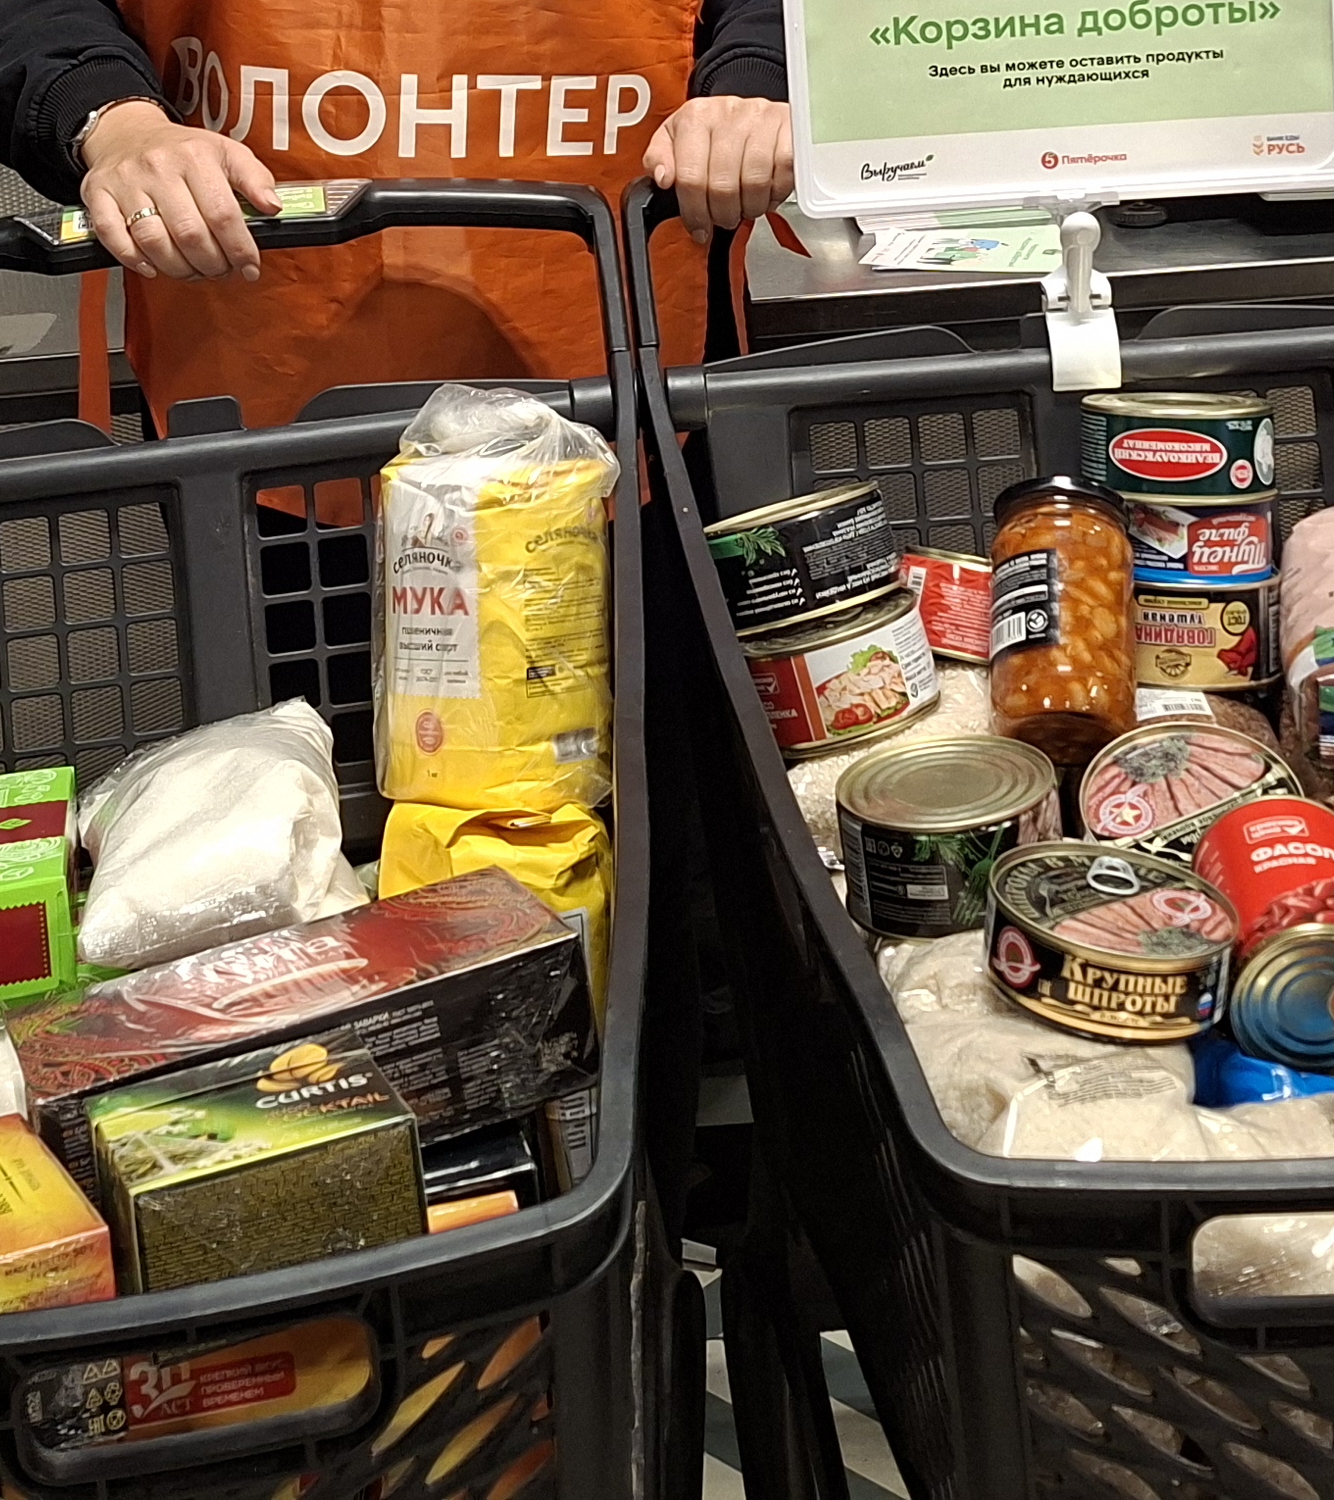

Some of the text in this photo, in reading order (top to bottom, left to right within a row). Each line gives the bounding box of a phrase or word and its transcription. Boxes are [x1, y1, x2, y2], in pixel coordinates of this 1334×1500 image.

[868, 6, 1066, 51] «Корзина
[927, 46, 1225, 78] Здесь вы можете оставить продукты
[1002, 68, 1150, 90] для нуждающихся
[170, 36, 652, 159] ВОЛОНТЕР
[1060, 151, 1128, 167] Пятёрочка
[1267, 143, 1306, 155] РУСЬ
[1192, 536, 1267, 575] Тунец
[392, 586, 470, 616] МУКА
[1135, 625, 1215, 646] ГОВЯДИНА
[1254, 857, 1317, 874] КРАСНАЯ
[1061, 956, 1188, 996] КРУПНЫЕ
[1067, 983, 1179, 1015] ШПРОТЫ
[256, 1072, 369, 1110] CURTIS
